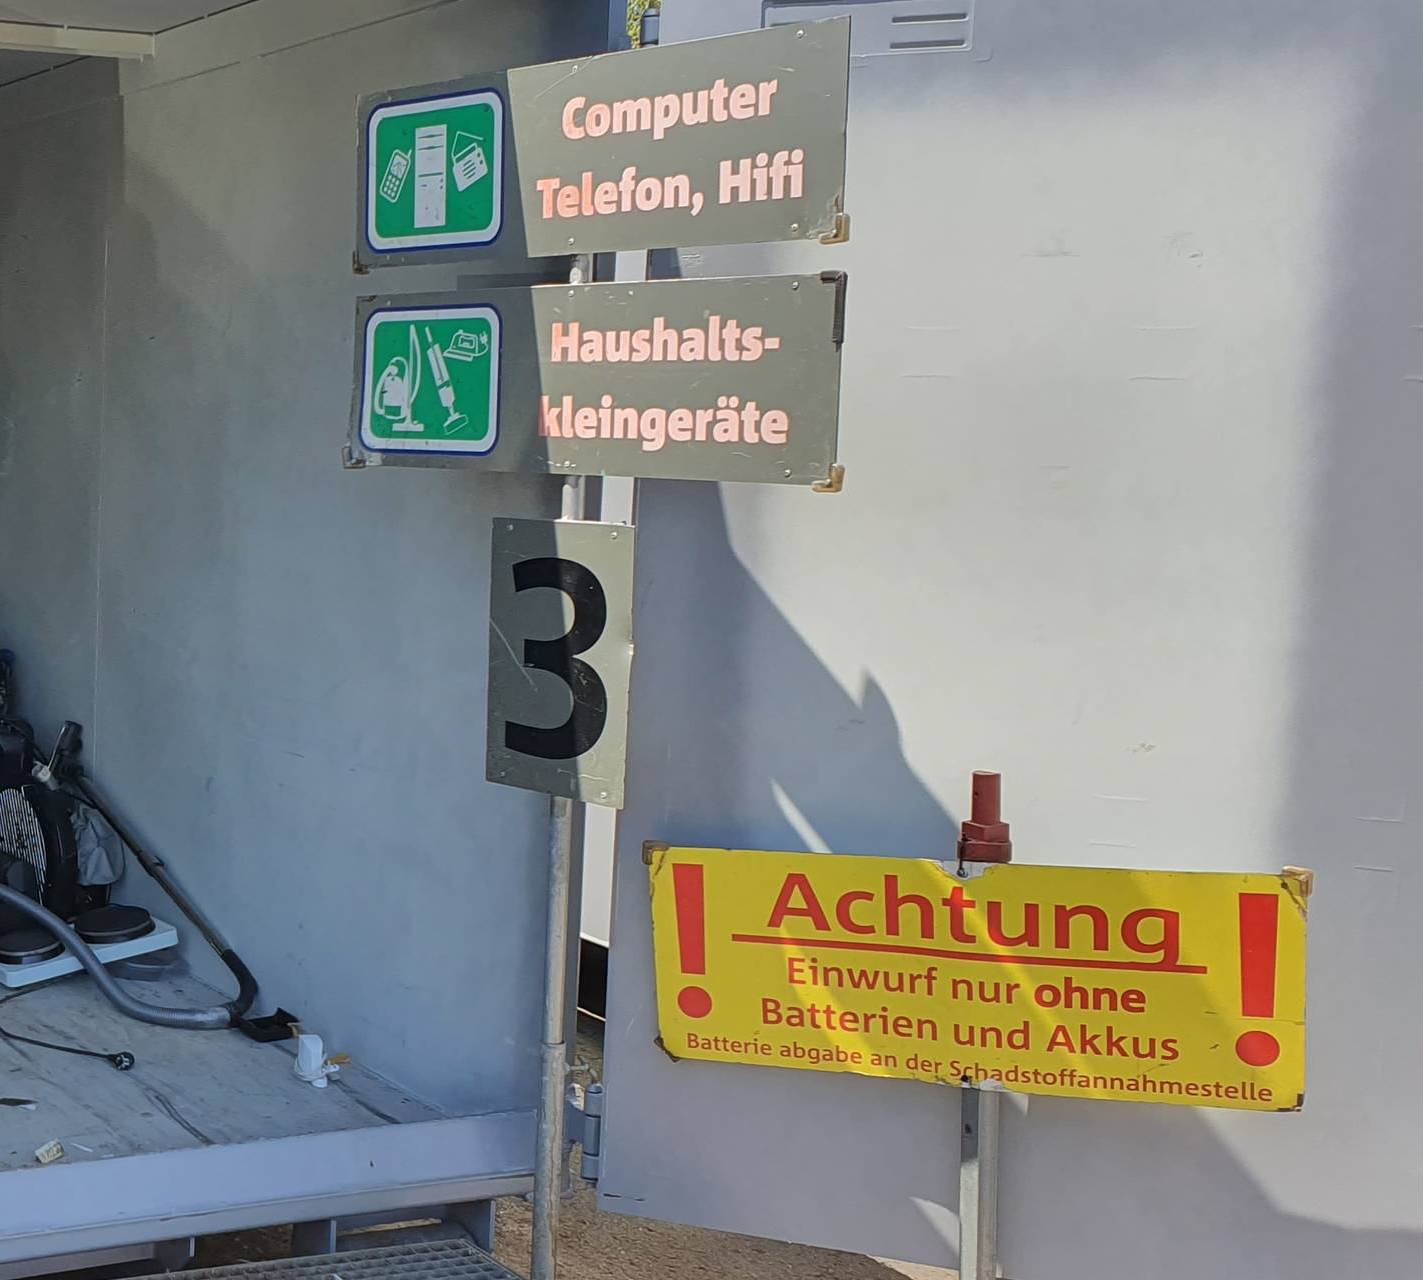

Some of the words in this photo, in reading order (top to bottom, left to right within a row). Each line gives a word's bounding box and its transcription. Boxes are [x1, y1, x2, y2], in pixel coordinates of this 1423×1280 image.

[561, 78, 778, 141] Computer
[537, 166, 705, 219] Telefon,
[719, 149, 805, 203] Hifi
[550, 315, 781, 363] Haushalts-
[538, 395, 789, 452] kleingeräte
[505, 557, 607, 760] 3
[767, 872, 1181, 968] Achtung
[787, 957, 938, 996] Einwurf
[951, 976, 1021, 1004] nur
[1034, 976, 1147, 1013] ohne
[761, 997, 938, 1042] Batterien
[953, 1020, 1030, 1051] und
[1046, 1023, 1180, 1061] Akkus
[686, 1032, 772, 1056] Batterie
[779, 1041, 863, 1065] abgabe
[870, 1051, 898, 1068] an
[905, 1053, 943, 1074] der
[950, 1059, 1273, 1102] Schadstoffannahmestelle
